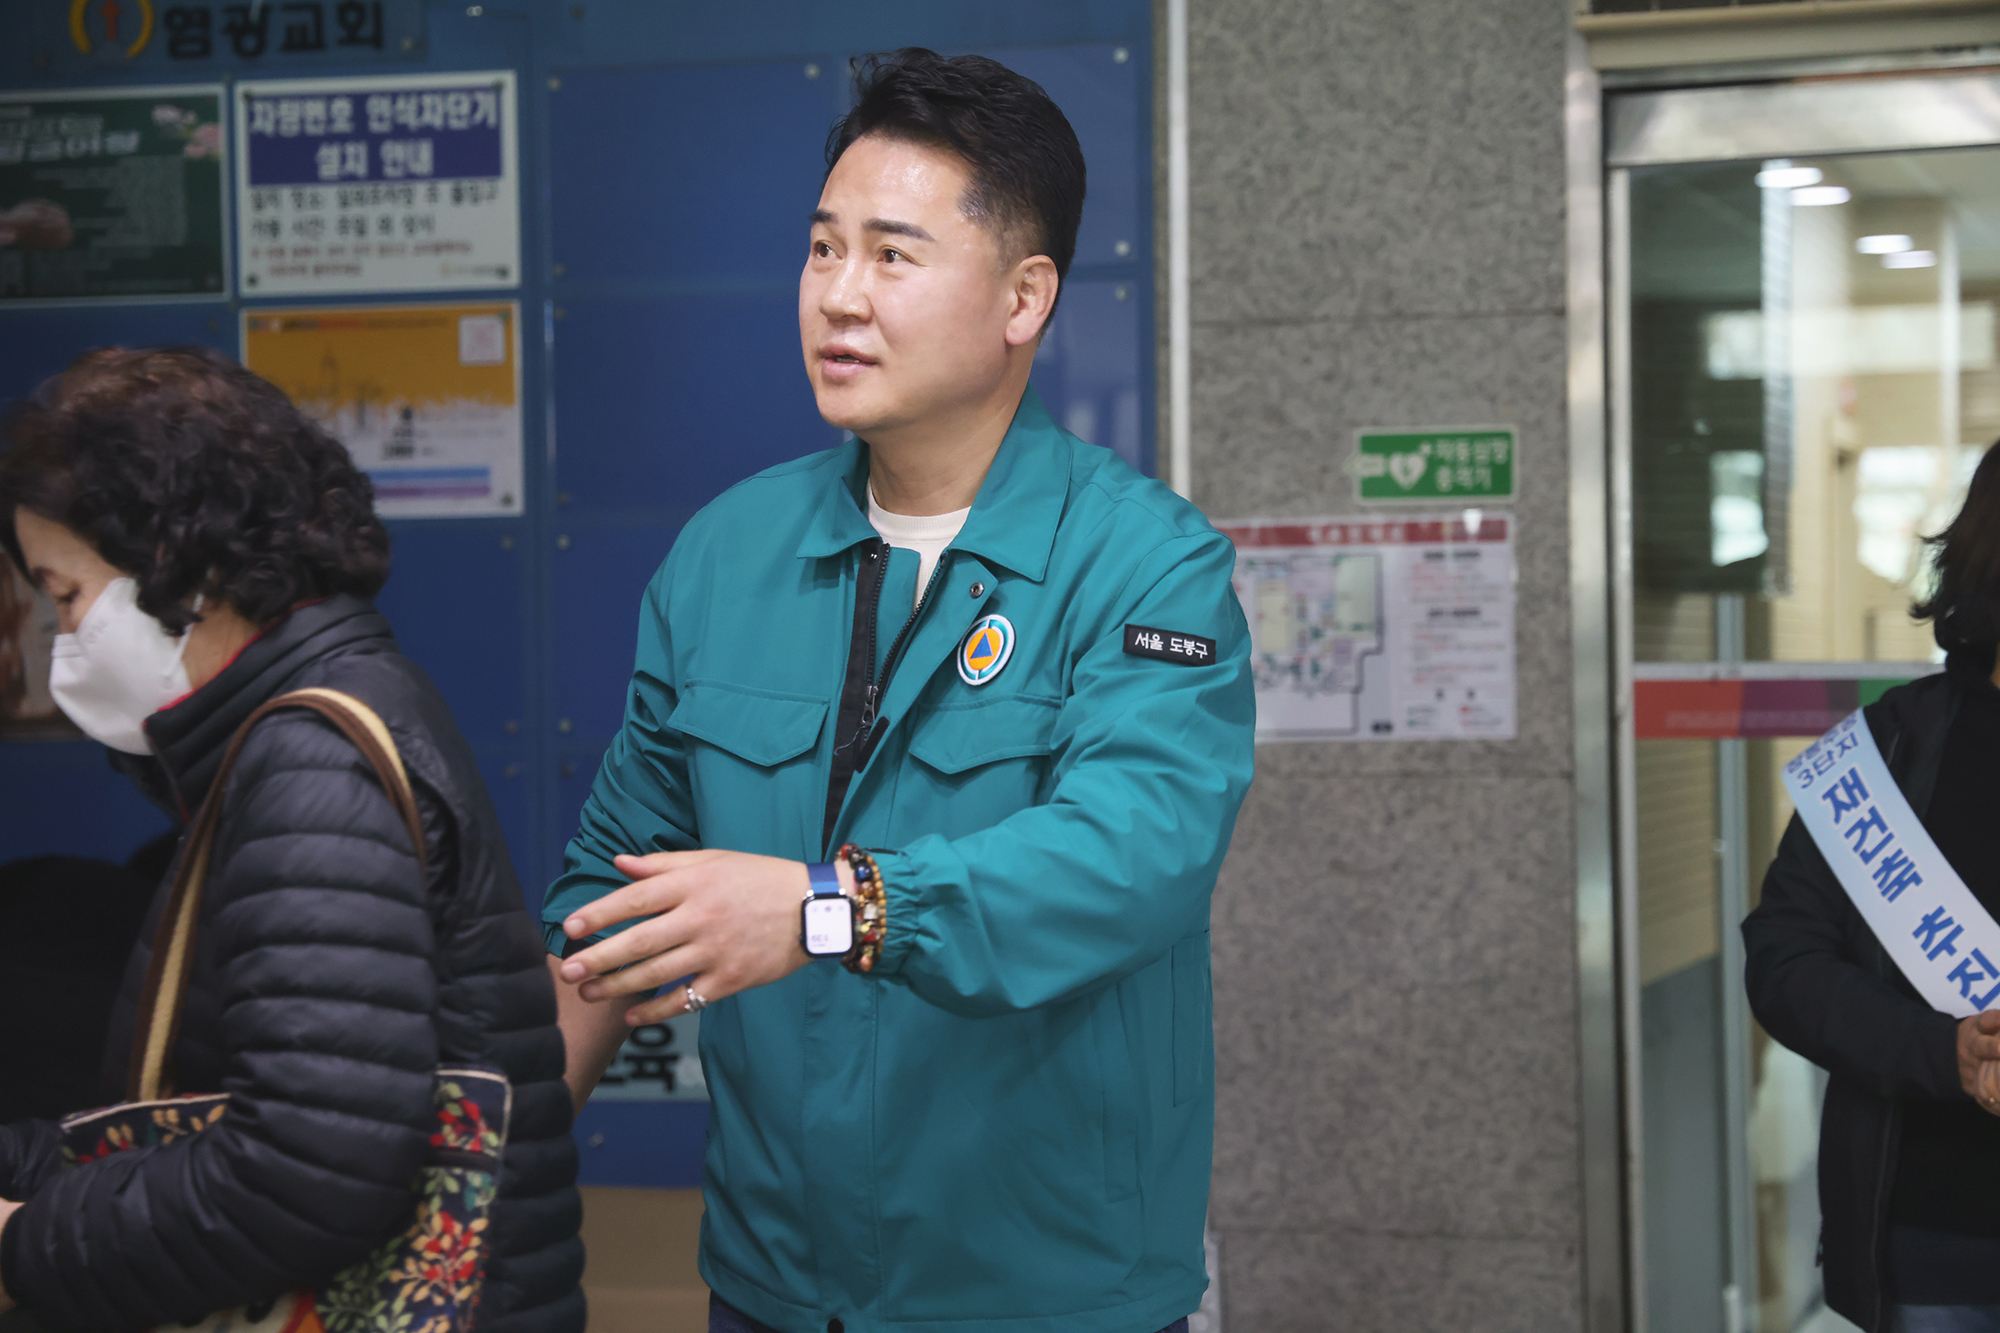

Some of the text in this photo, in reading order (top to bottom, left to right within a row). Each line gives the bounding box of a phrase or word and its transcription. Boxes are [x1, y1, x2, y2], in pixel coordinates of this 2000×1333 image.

[165, 2, 384, 58] 염광교회
[251, 91, 498, 137] 차량번호 인식차단기
[315, 138, 434, 180] 설치 안내
[1134, 631, 1208, 659] 서울 도봉구
[1796, 733, 1859, 789] 3단지
[1821, 767, 2000, 1012] 재건축 추진
